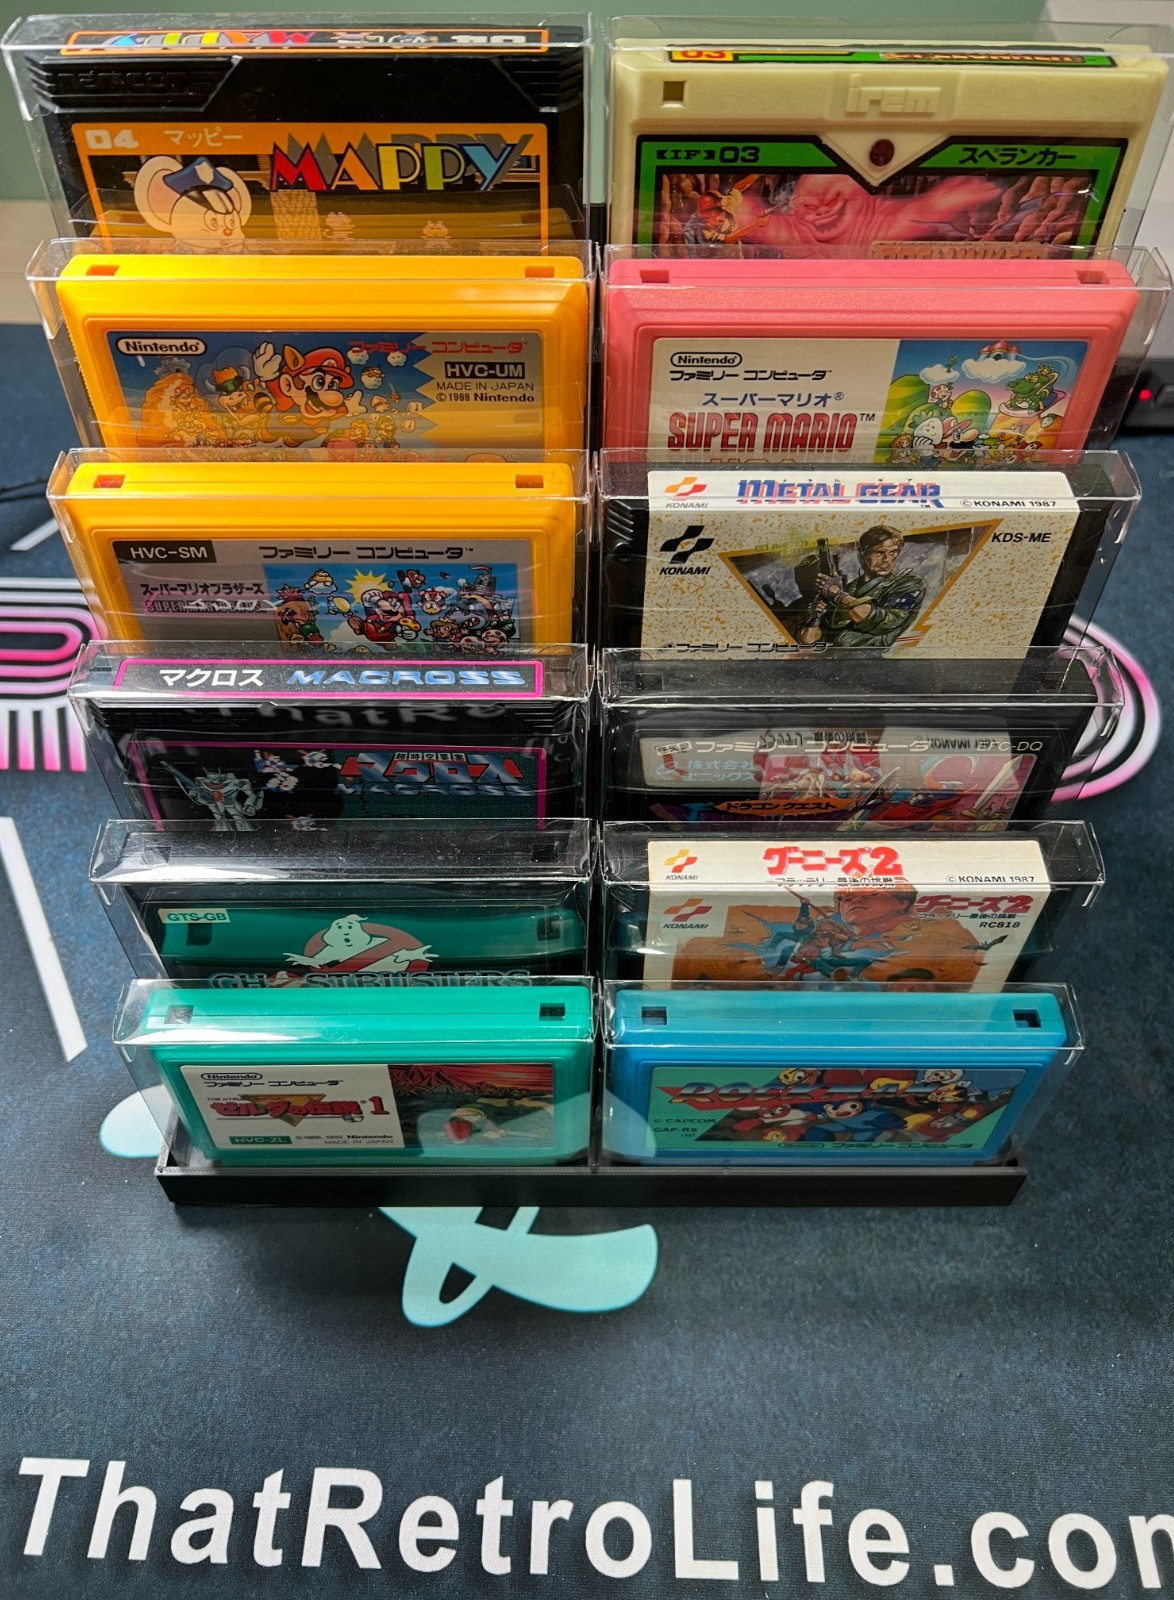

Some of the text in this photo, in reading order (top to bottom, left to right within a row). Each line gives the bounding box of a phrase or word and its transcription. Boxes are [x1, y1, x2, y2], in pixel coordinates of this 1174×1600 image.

[84, 128, 139, 150] 04
[163, 126, 243, 148] マッピー
[958, 146, 1077, 166] スペランカー
[270, 142, 515, 191] MAPPY
[124, 341, 200, 353] Nintendo
[677, 355, 738, 365] Nintendo
[446, 364, 523, 378] HVC-UM
[669, 370, 740, 381] ファミリー
[436, 381, 535, 391] MADE IN JAPAN
[473, 393, 535, 402] Nintendo
[667, 411, 759, 453] SUPER
[763, 411, 858, 453] MARIO
[736, 479, 851, 505] METAL
[855, 482, 945, 509] GEAR
[1029, 500, 1057, 508] 1987
[991, 532, 1052, 543] KDS-ME
[129, 546, 209, 559] HVC-SM
[259, 546, 351, 560] ファミリー
[659, 566, 711, 576] KONAMI
[159, 668, 264, 687] マクロス
[286, 670, 526, 685] MACROSS
[976, 741, 1043, 752] EFC-DQ
[334, 783, 534, 797] MACROSS
[726, 801, 837, 811] ドラゴン クエスト
[762, 845, 904, 877] グーニーズ2
[167, 911, 227, 922] GTS-GB
[979, 921, 1021, 929] RC818
